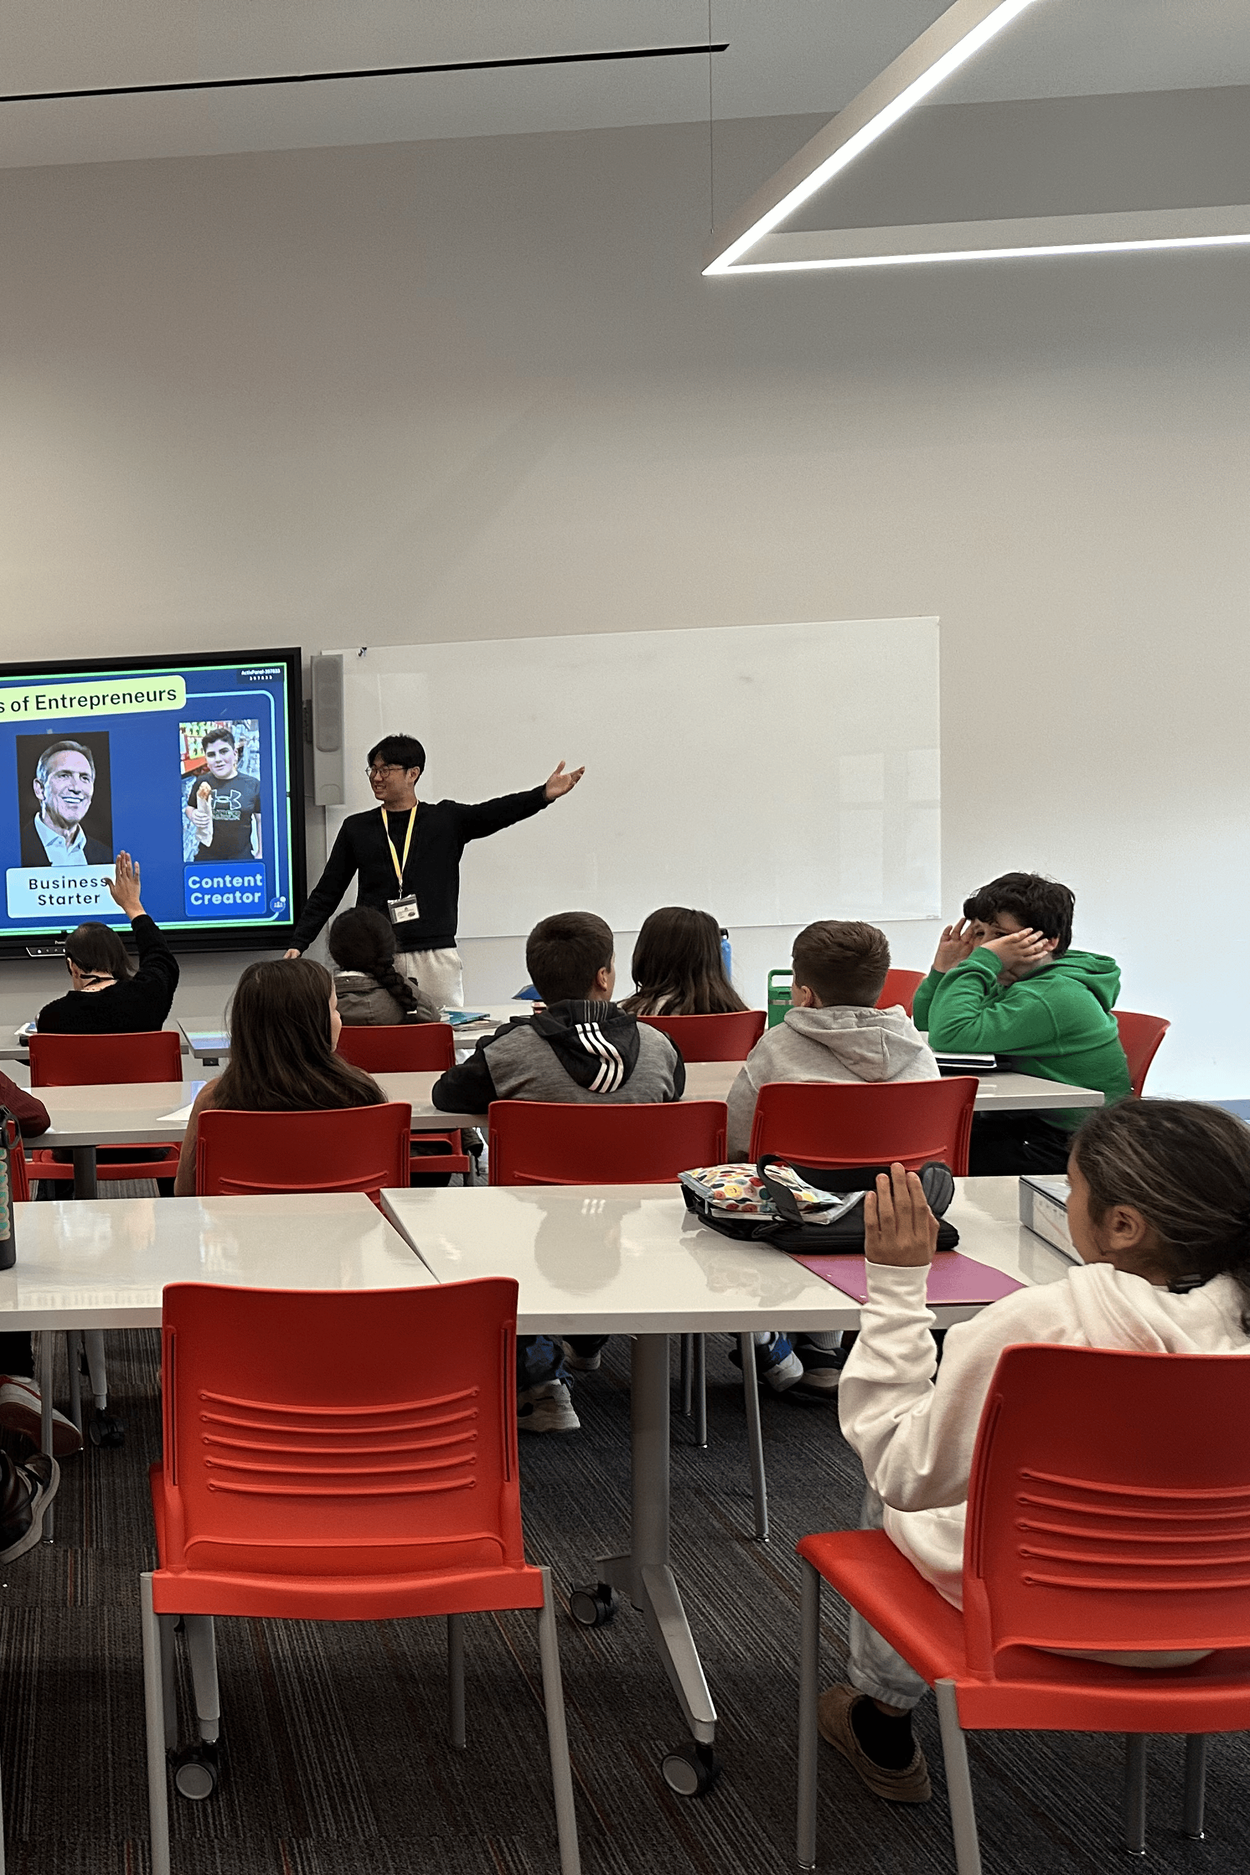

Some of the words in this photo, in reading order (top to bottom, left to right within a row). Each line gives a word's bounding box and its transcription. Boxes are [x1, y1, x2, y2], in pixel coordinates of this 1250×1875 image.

[10, 695, 29, 712] of
[35, 689, 177, 710] Entrepreneurs
[29, 876, 108, 890] Business
[188, 873, 262, 889] Content
[38, 893, 100, 906] Starter
[190, 891, 261, 905] Creator
